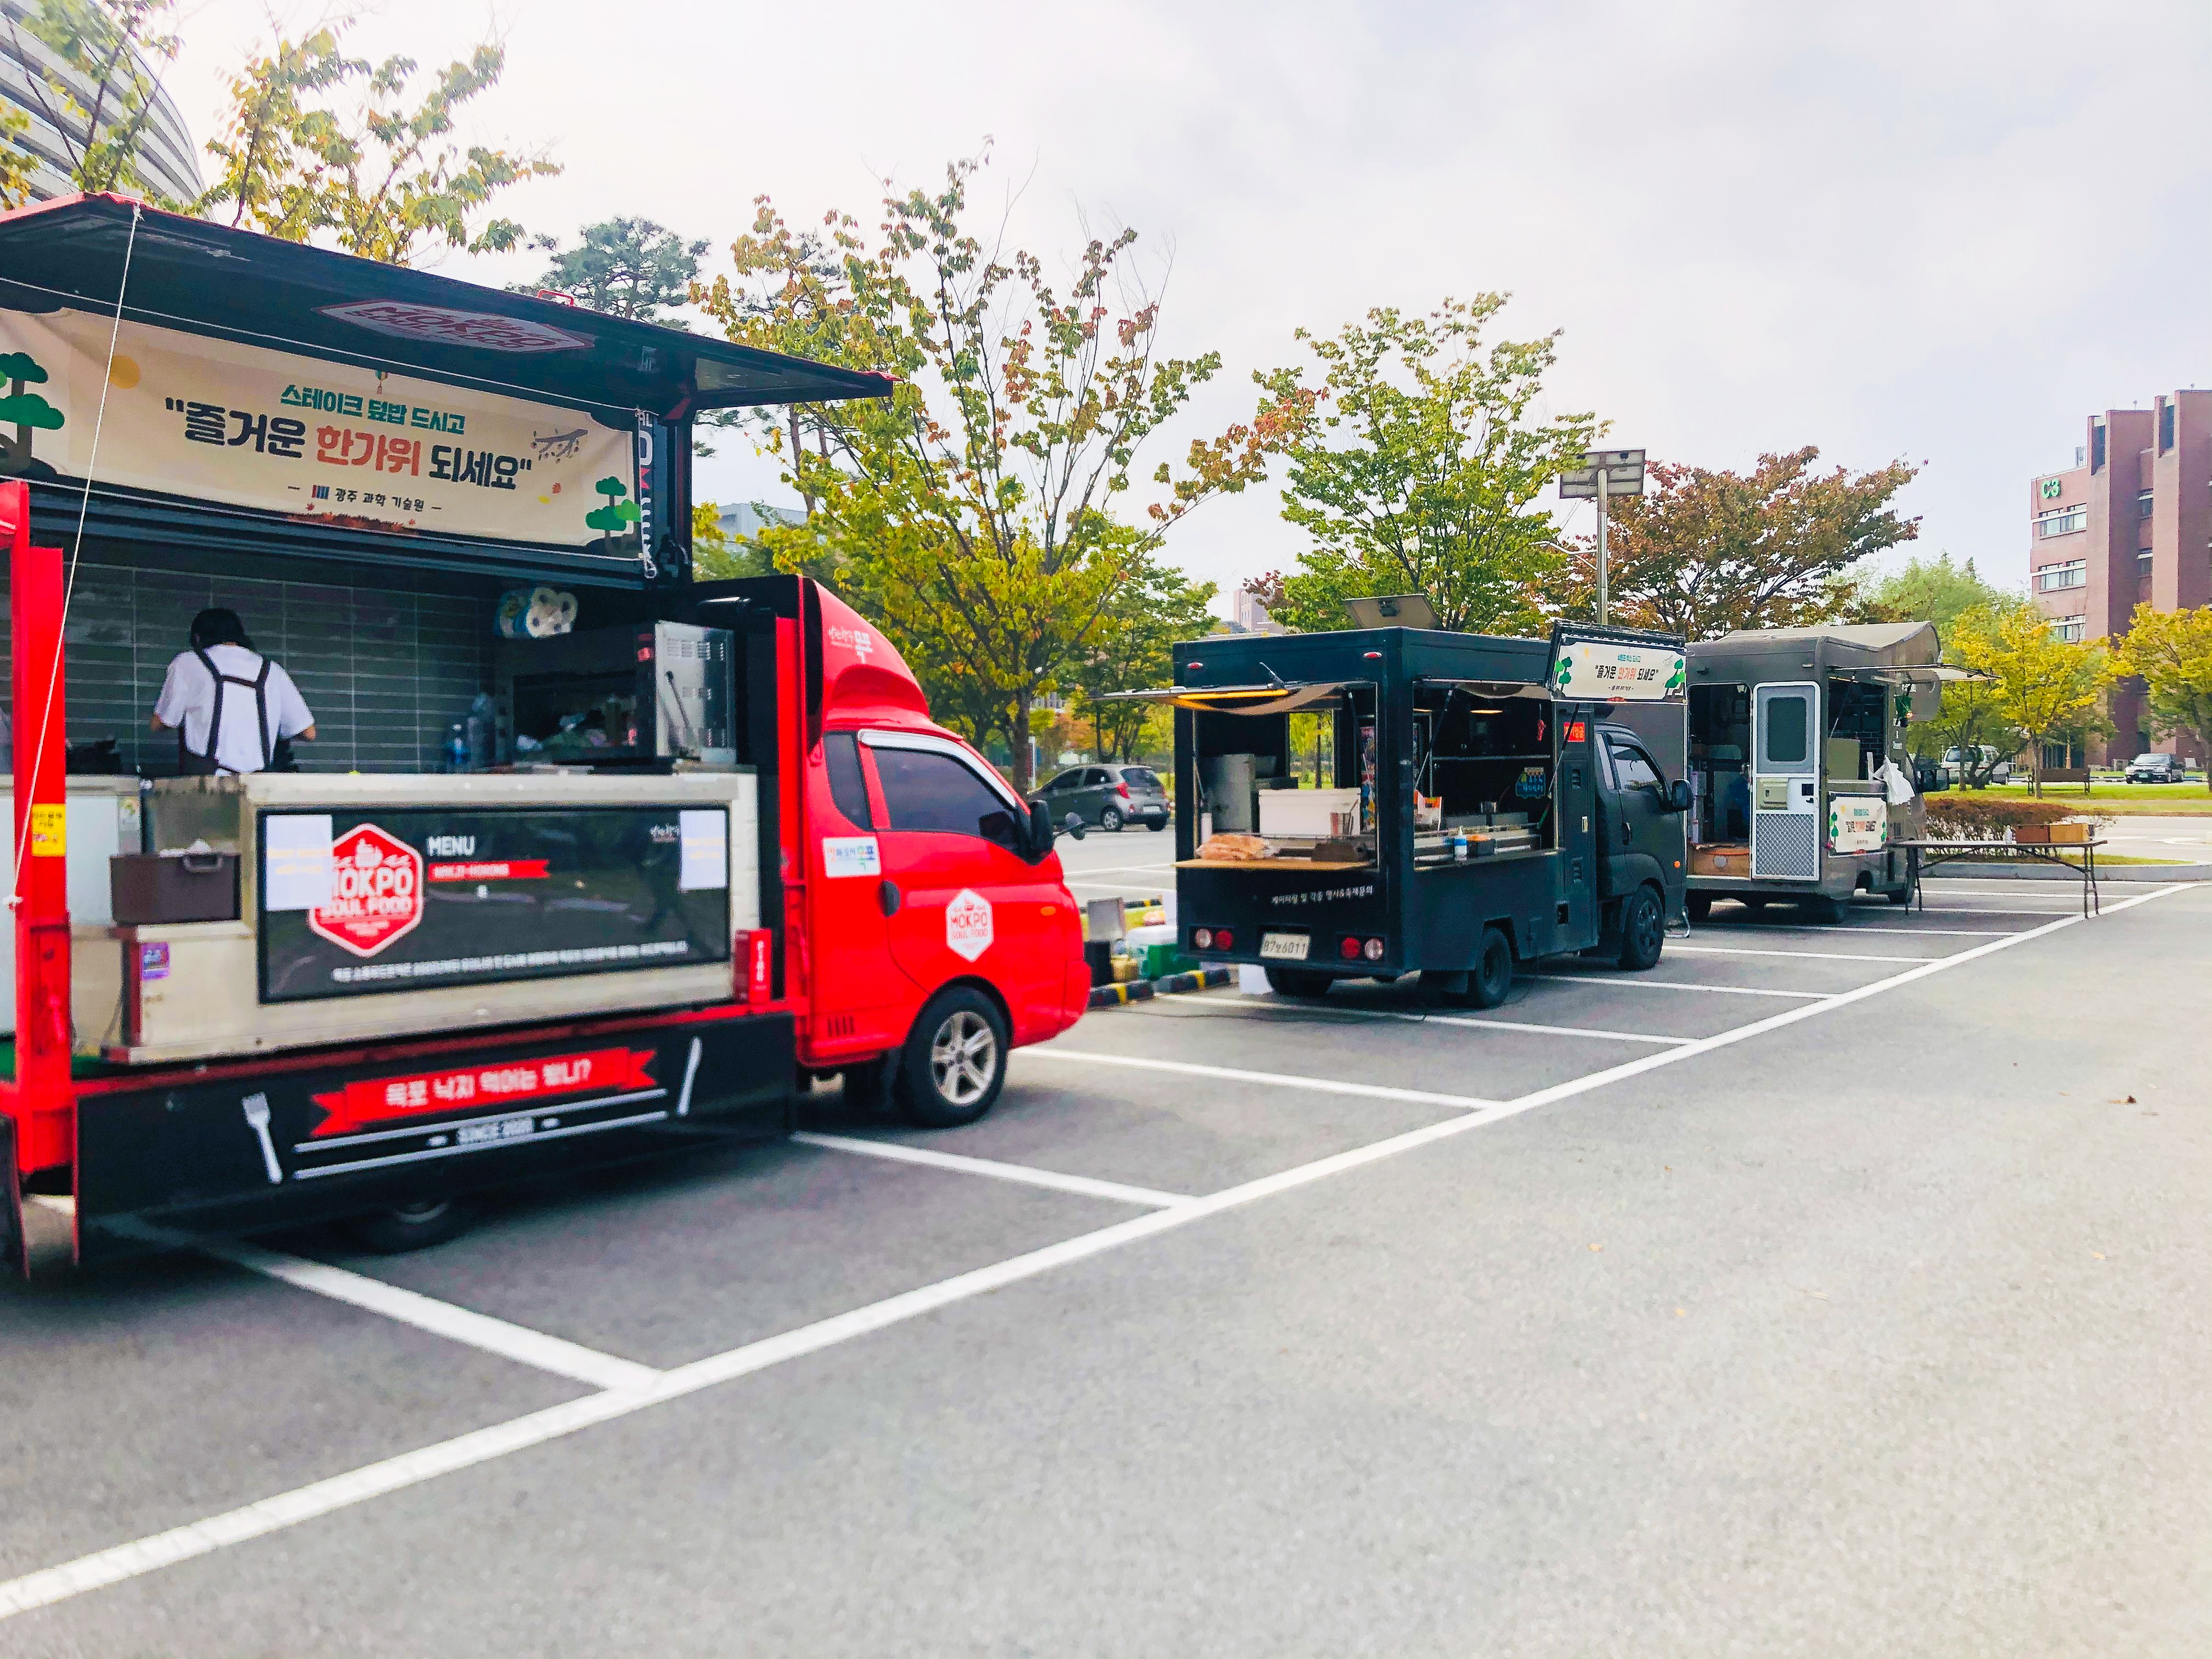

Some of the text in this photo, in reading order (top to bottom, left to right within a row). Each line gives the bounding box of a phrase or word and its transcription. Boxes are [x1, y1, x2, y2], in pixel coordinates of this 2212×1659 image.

[350, 306, 561, 347] MOKPO
[280, 383, 466, 435] 스테이크 덮밥 드시고
[165, 396, 532, 490] "즐거운 한가위 되세요"
[335, 487, 425, 512] 광주 과학 기술원
[2041, 478, 2059, 498] C3
[427, 835, 476, 856] MENU
[366, 895, 413, 916] FOOD
[951, 911, 987, 929] MOKPO
